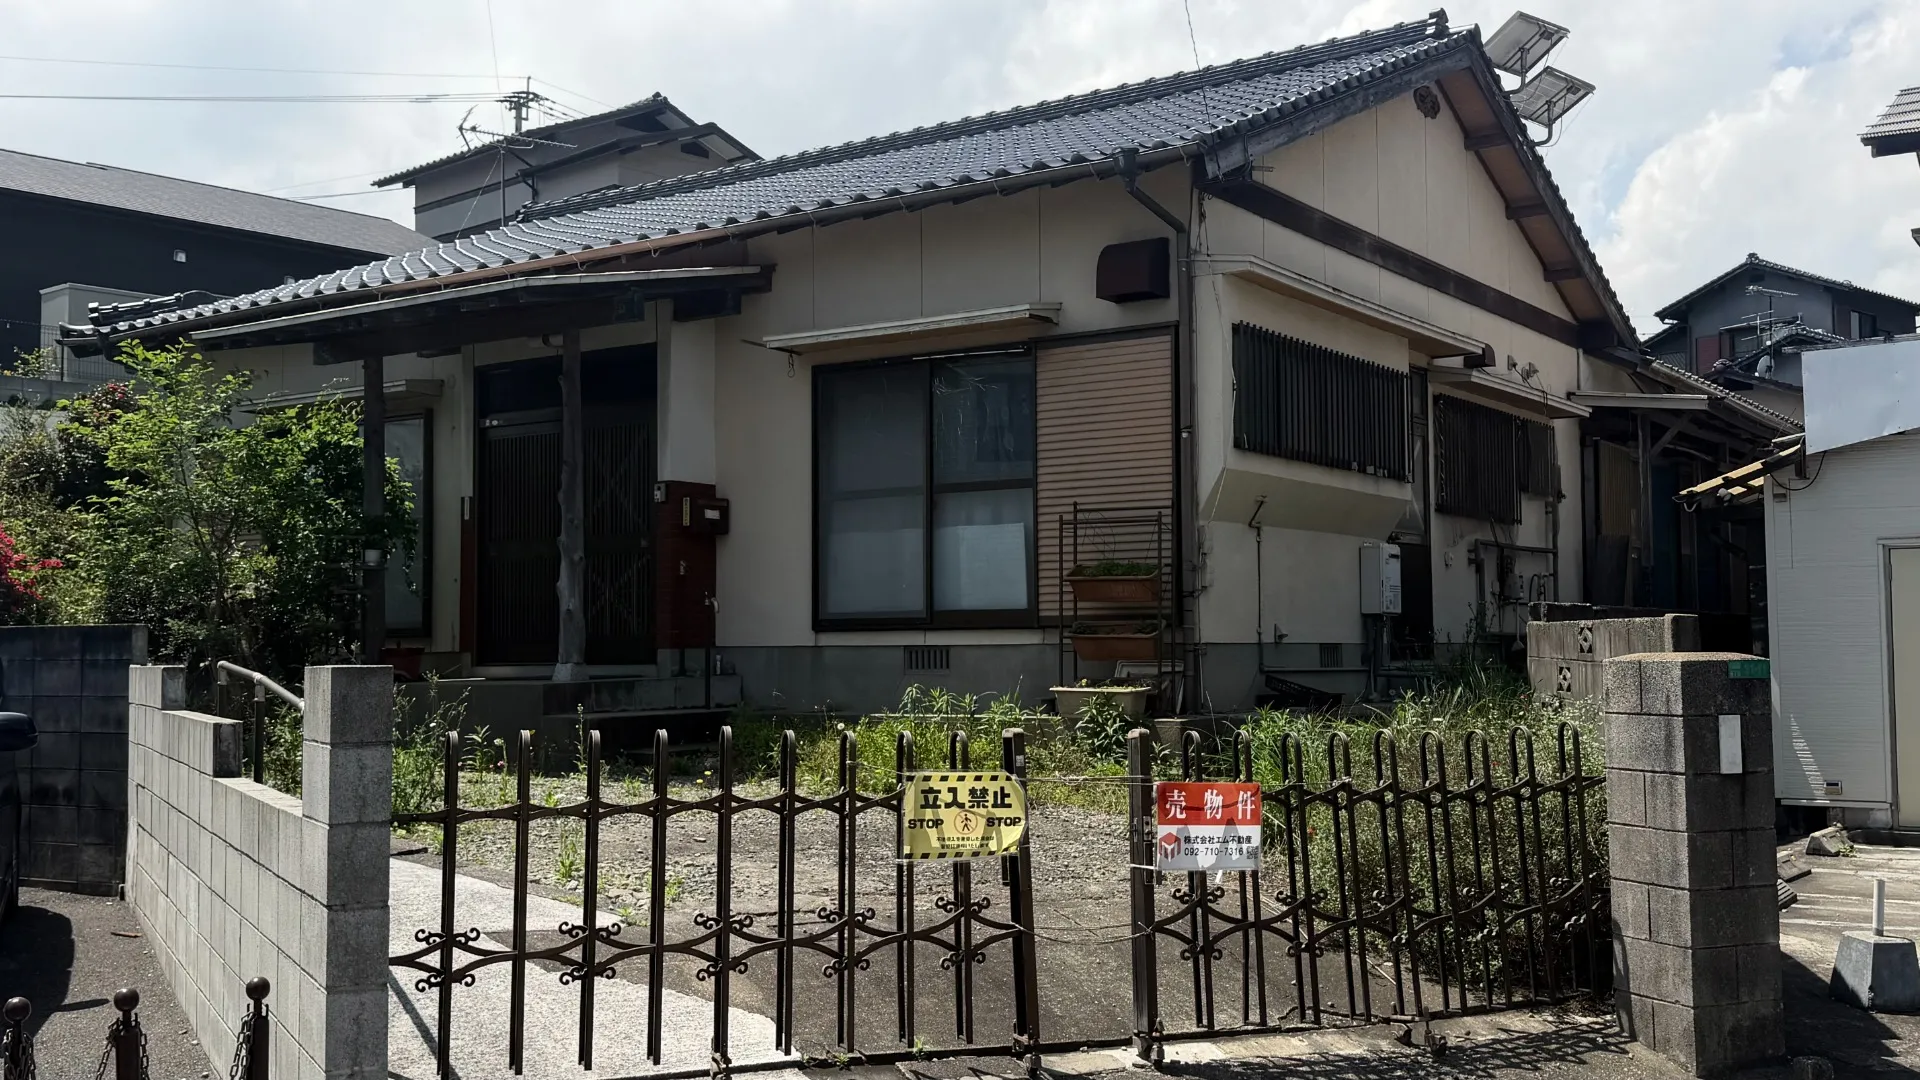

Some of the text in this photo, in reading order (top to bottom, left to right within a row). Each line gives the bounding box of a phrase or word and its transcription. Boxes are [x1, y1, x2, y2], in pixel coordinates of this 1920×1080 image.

[919, 786, 1013, 810] 立入禁止
[1165, 788, 1256, 820] 売物件
[908, 818, 944, 829] STOP
[986, 816, 1022, 828] STOP
[1183, 835, 1253, 845] 株式会社エム不動産
[1184, 847, 1244, 856] 092-710-7316
